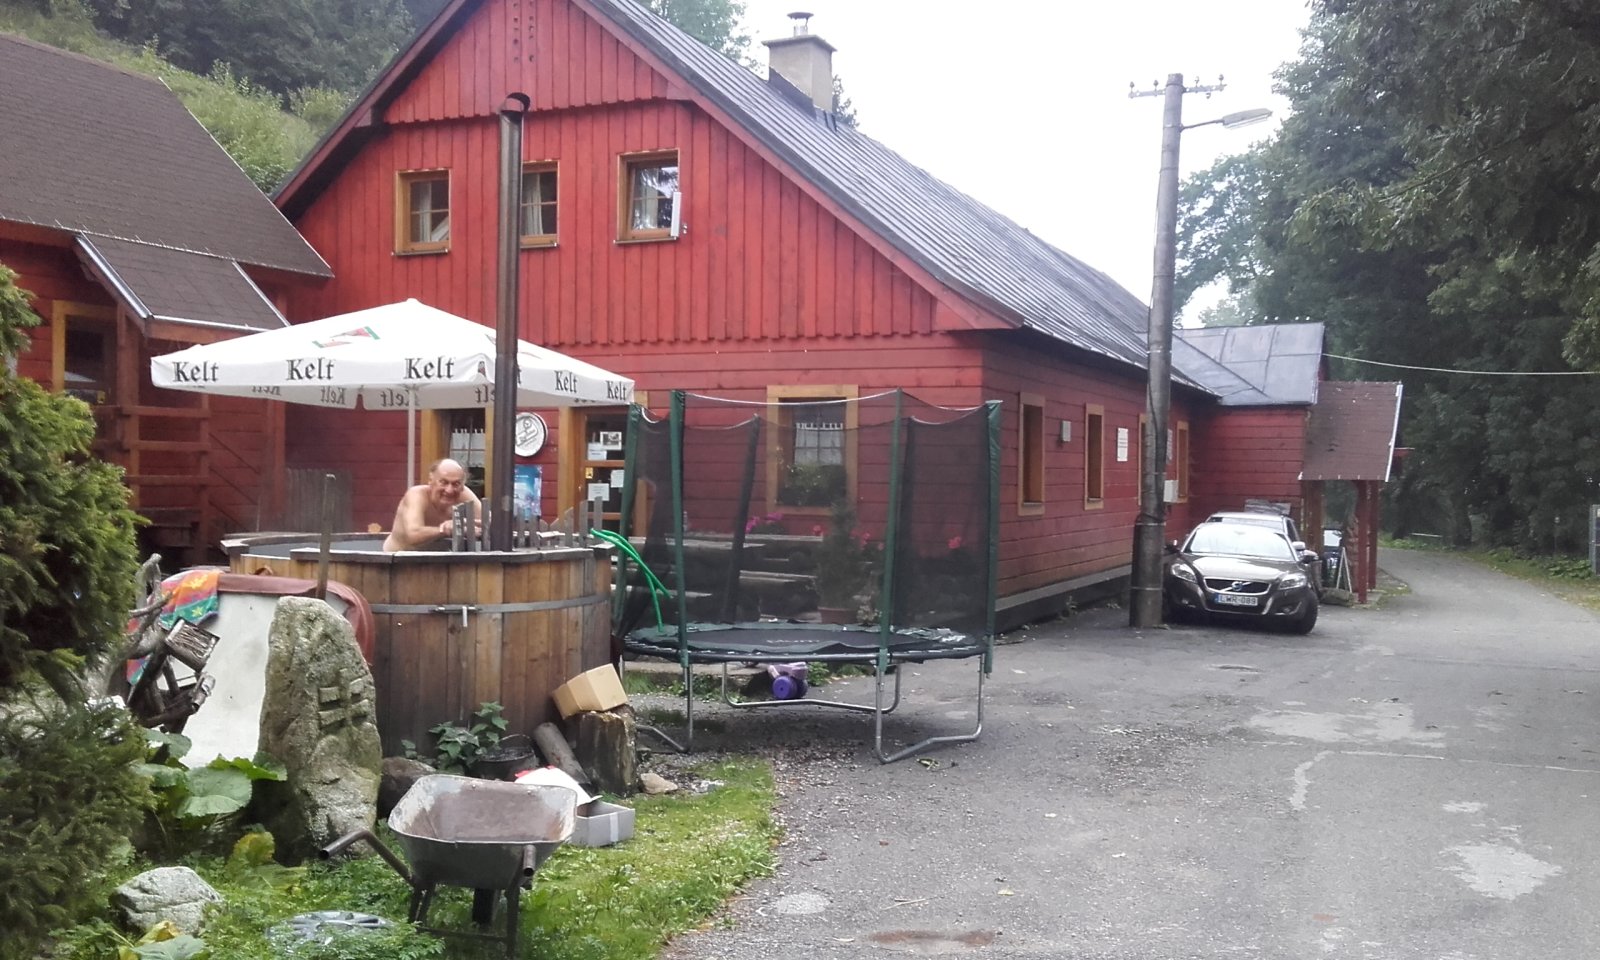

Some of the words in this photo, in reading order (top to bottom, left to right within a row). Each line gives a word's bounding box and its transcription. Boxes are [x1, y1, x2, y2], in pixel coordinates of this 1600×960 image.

[172, 360, 219, 382] Kelt
[286, 357, 335, 381] Kelt
[403, 355, 455, 380] Kelt
[554, 369, 578, 394] Kelt
[606, 380, 627, 401] Kelt
